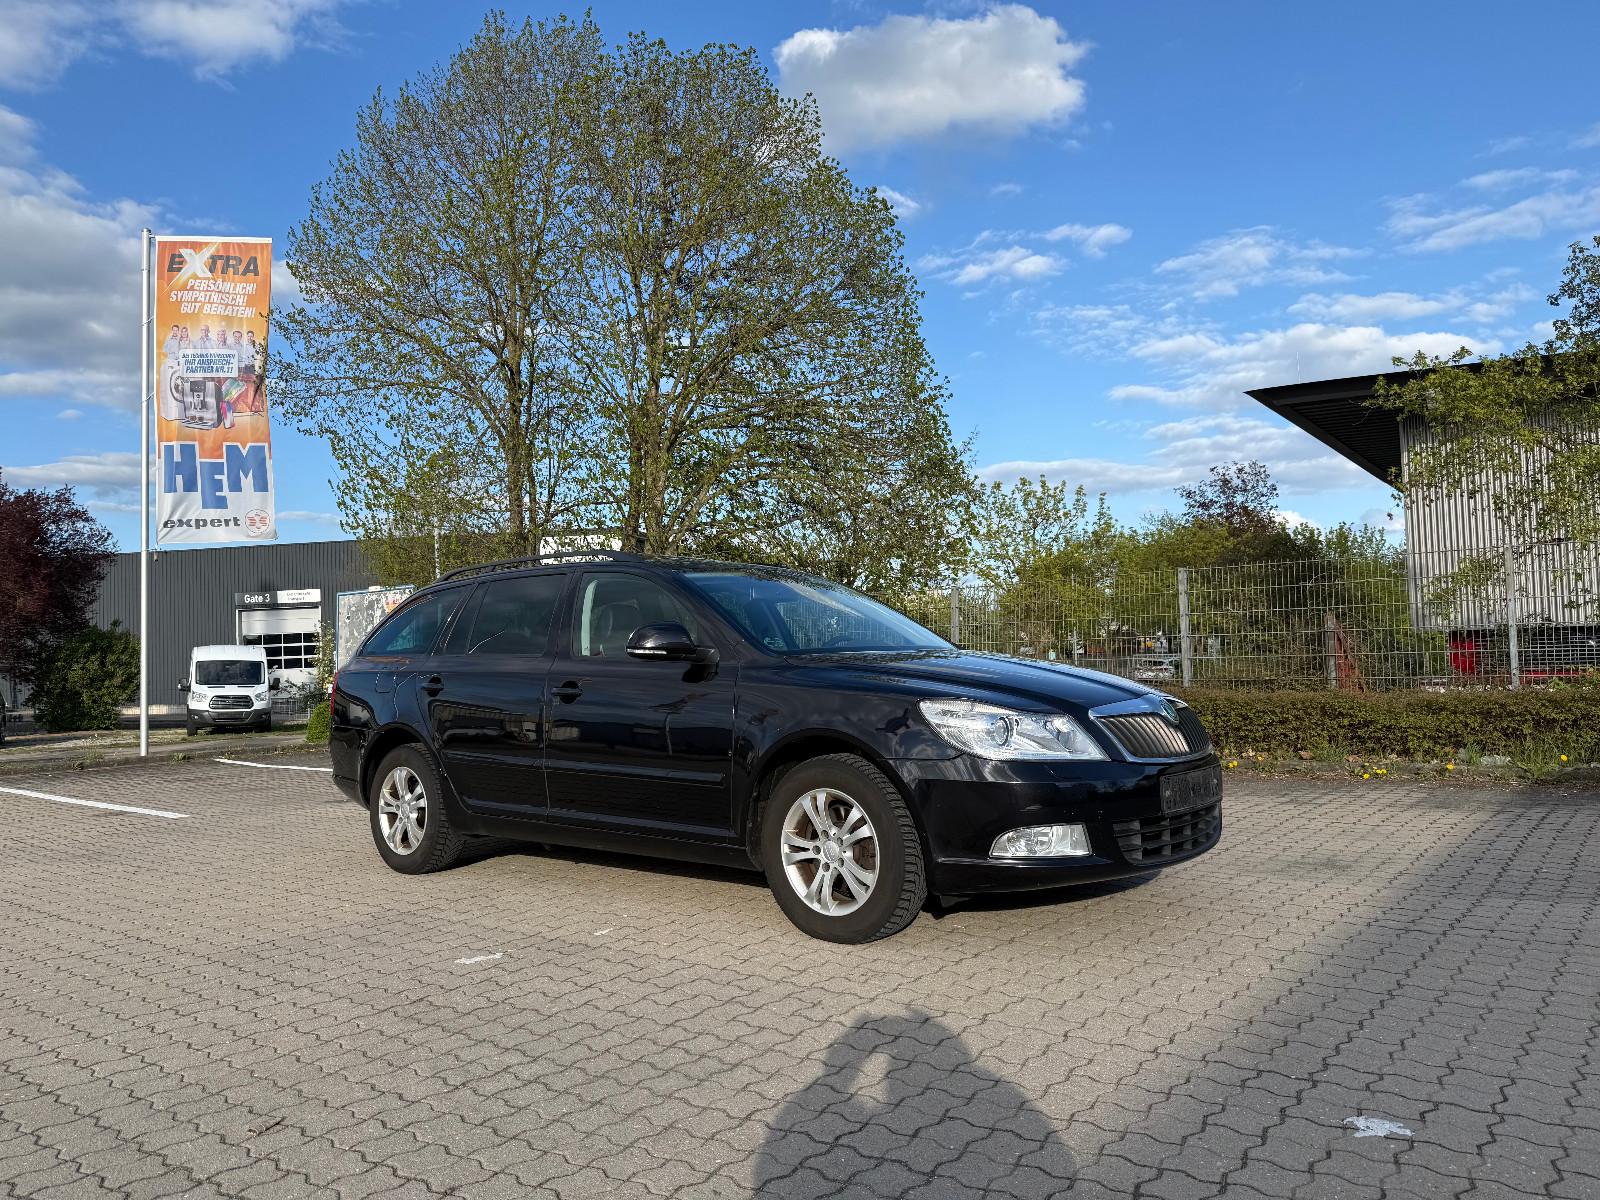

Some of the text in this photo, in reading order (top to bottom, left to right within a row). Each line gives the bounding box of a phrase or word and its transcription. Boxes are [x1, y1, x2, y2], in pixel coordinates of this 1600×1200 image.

[167, 247, 260, 278] EXTRA
[187, 279, 257, 295] PERSÖNLICH!
[170, 290, 247, 305] SYMPATHISCH!
[181, 303, 256, 318] GUT BERATEN!
[163, 443, 269, 509] HEM
[163, 516, 241, 529] expert
[244, 593, 270, 603] Gate 3
